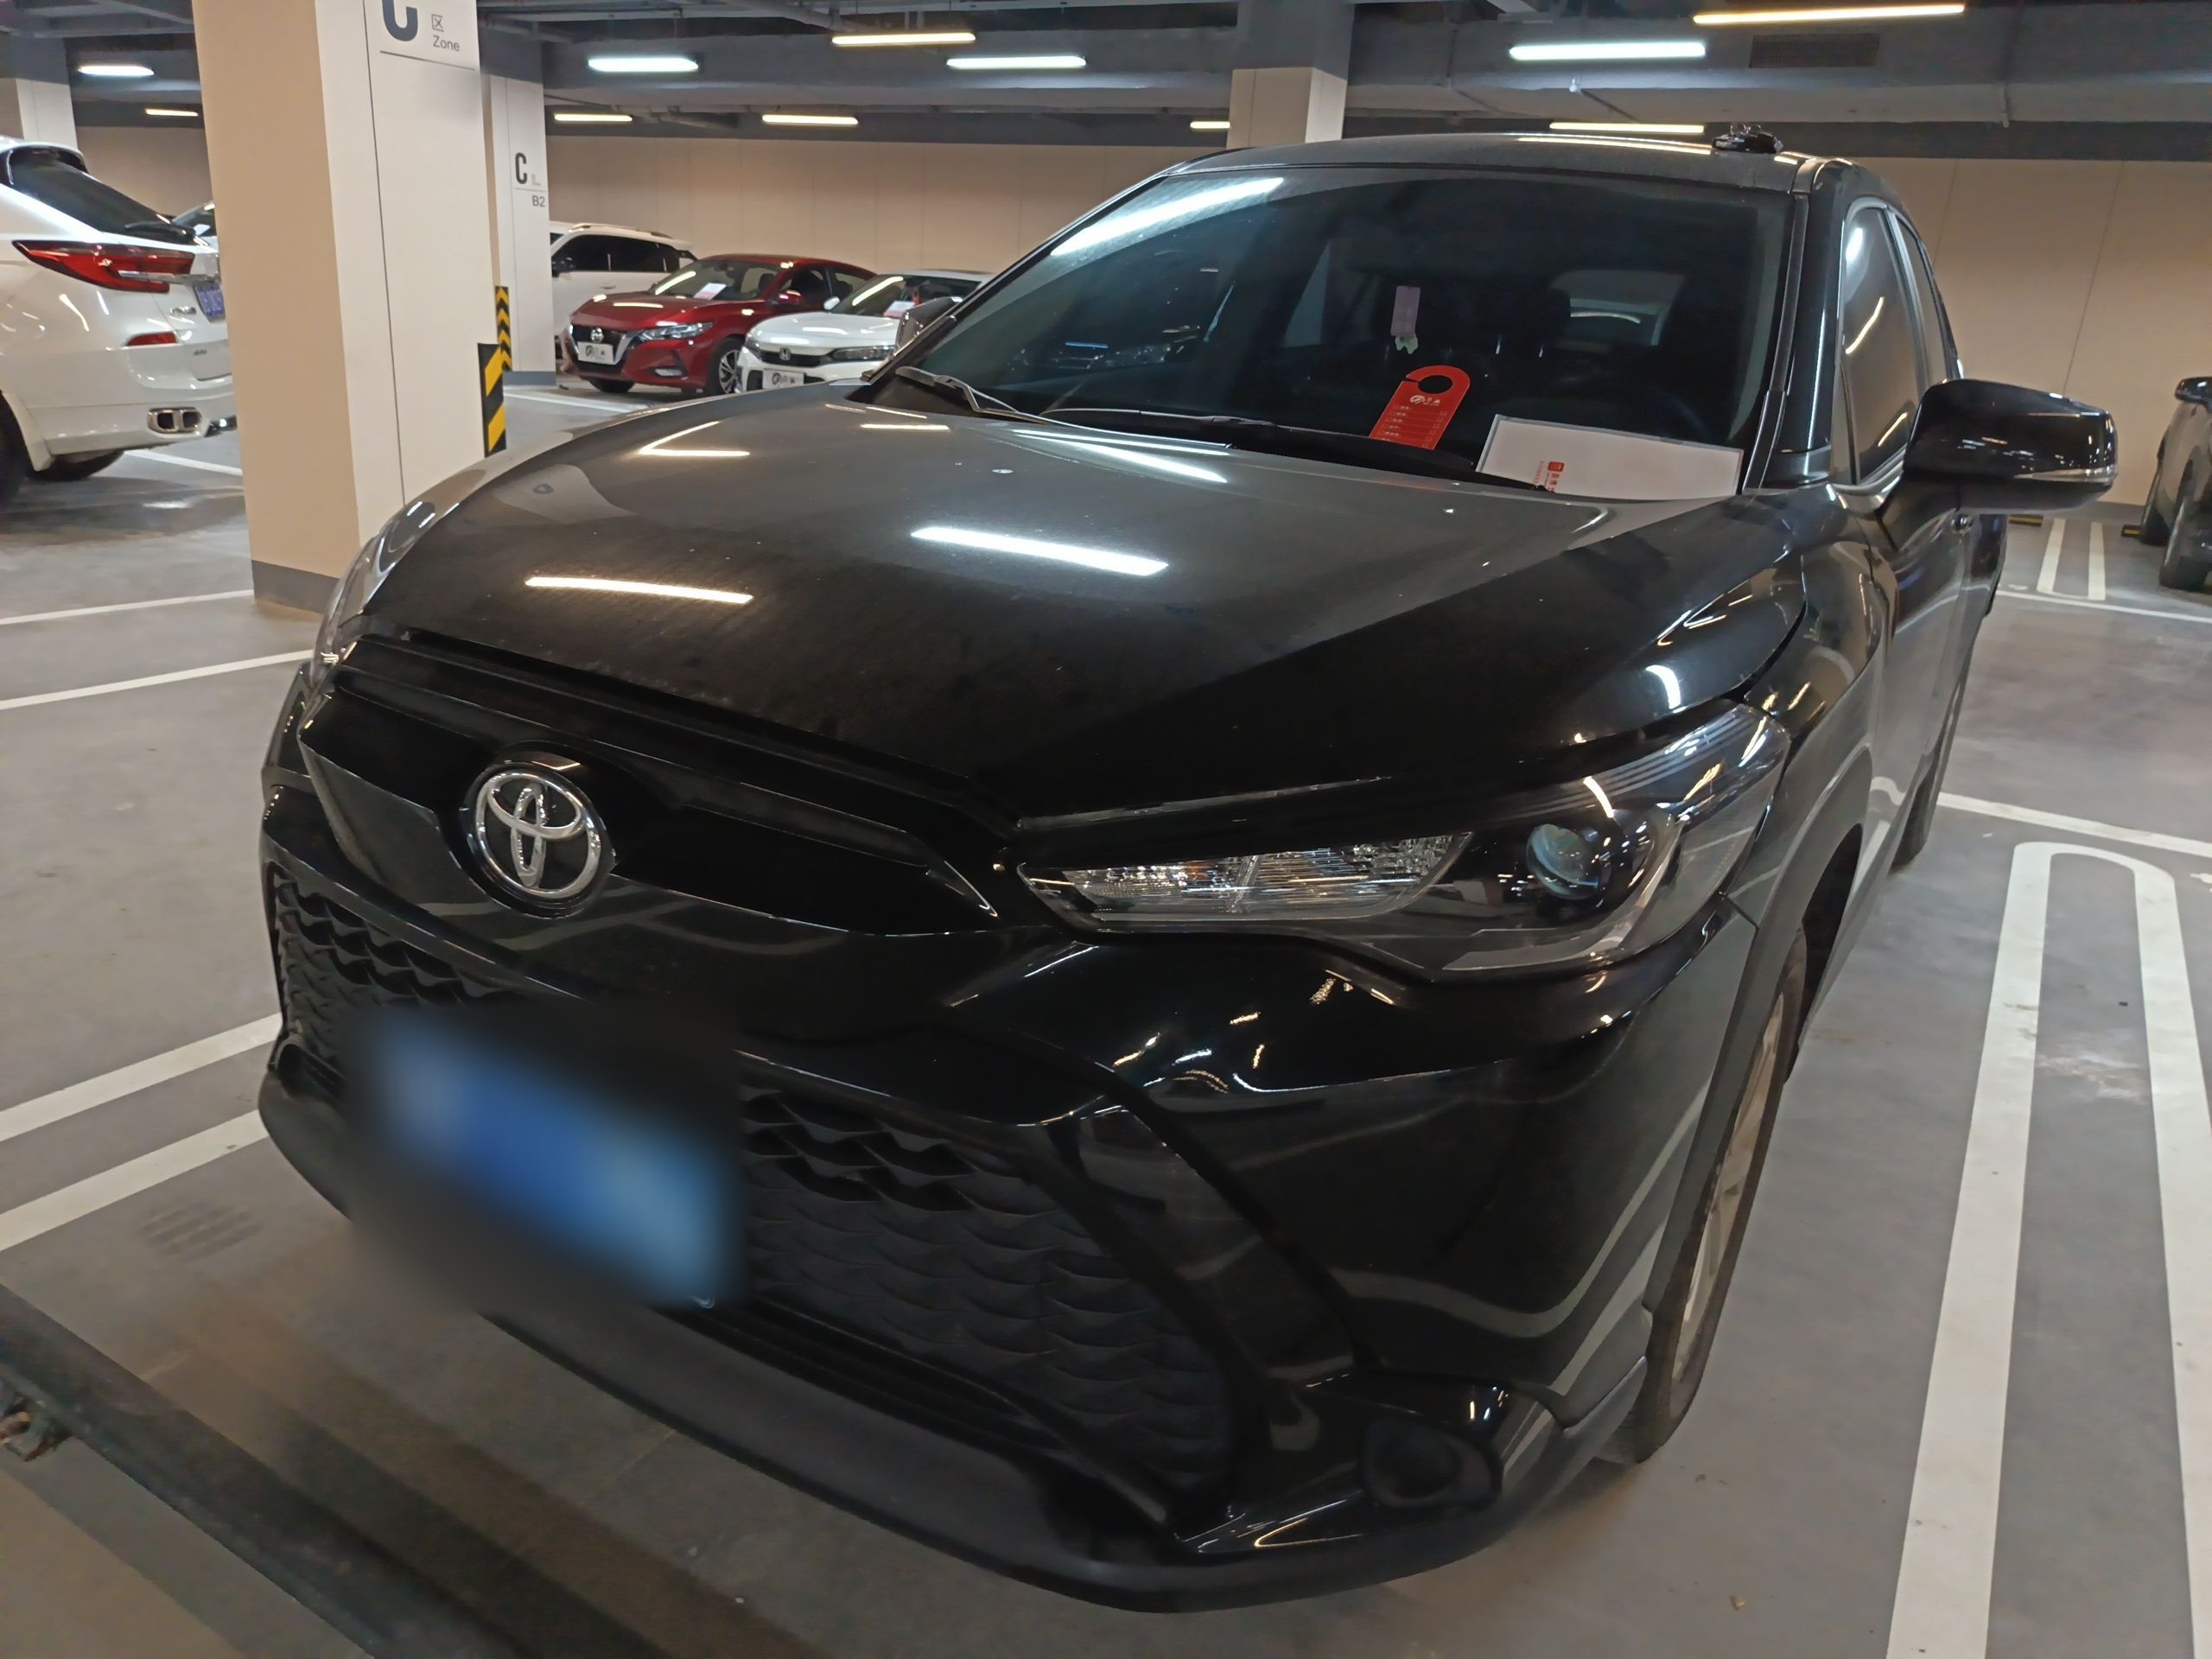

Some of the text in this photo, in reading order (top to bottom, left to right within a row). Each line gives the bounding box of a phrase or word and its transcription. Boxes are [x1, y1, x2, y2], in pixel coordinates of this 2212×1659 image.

[431, 14, 445, 32] 区
[433, 35, 461, 52] Zone
[515, 152, 528, 184] C
[532, 194, 546, 207] B2
